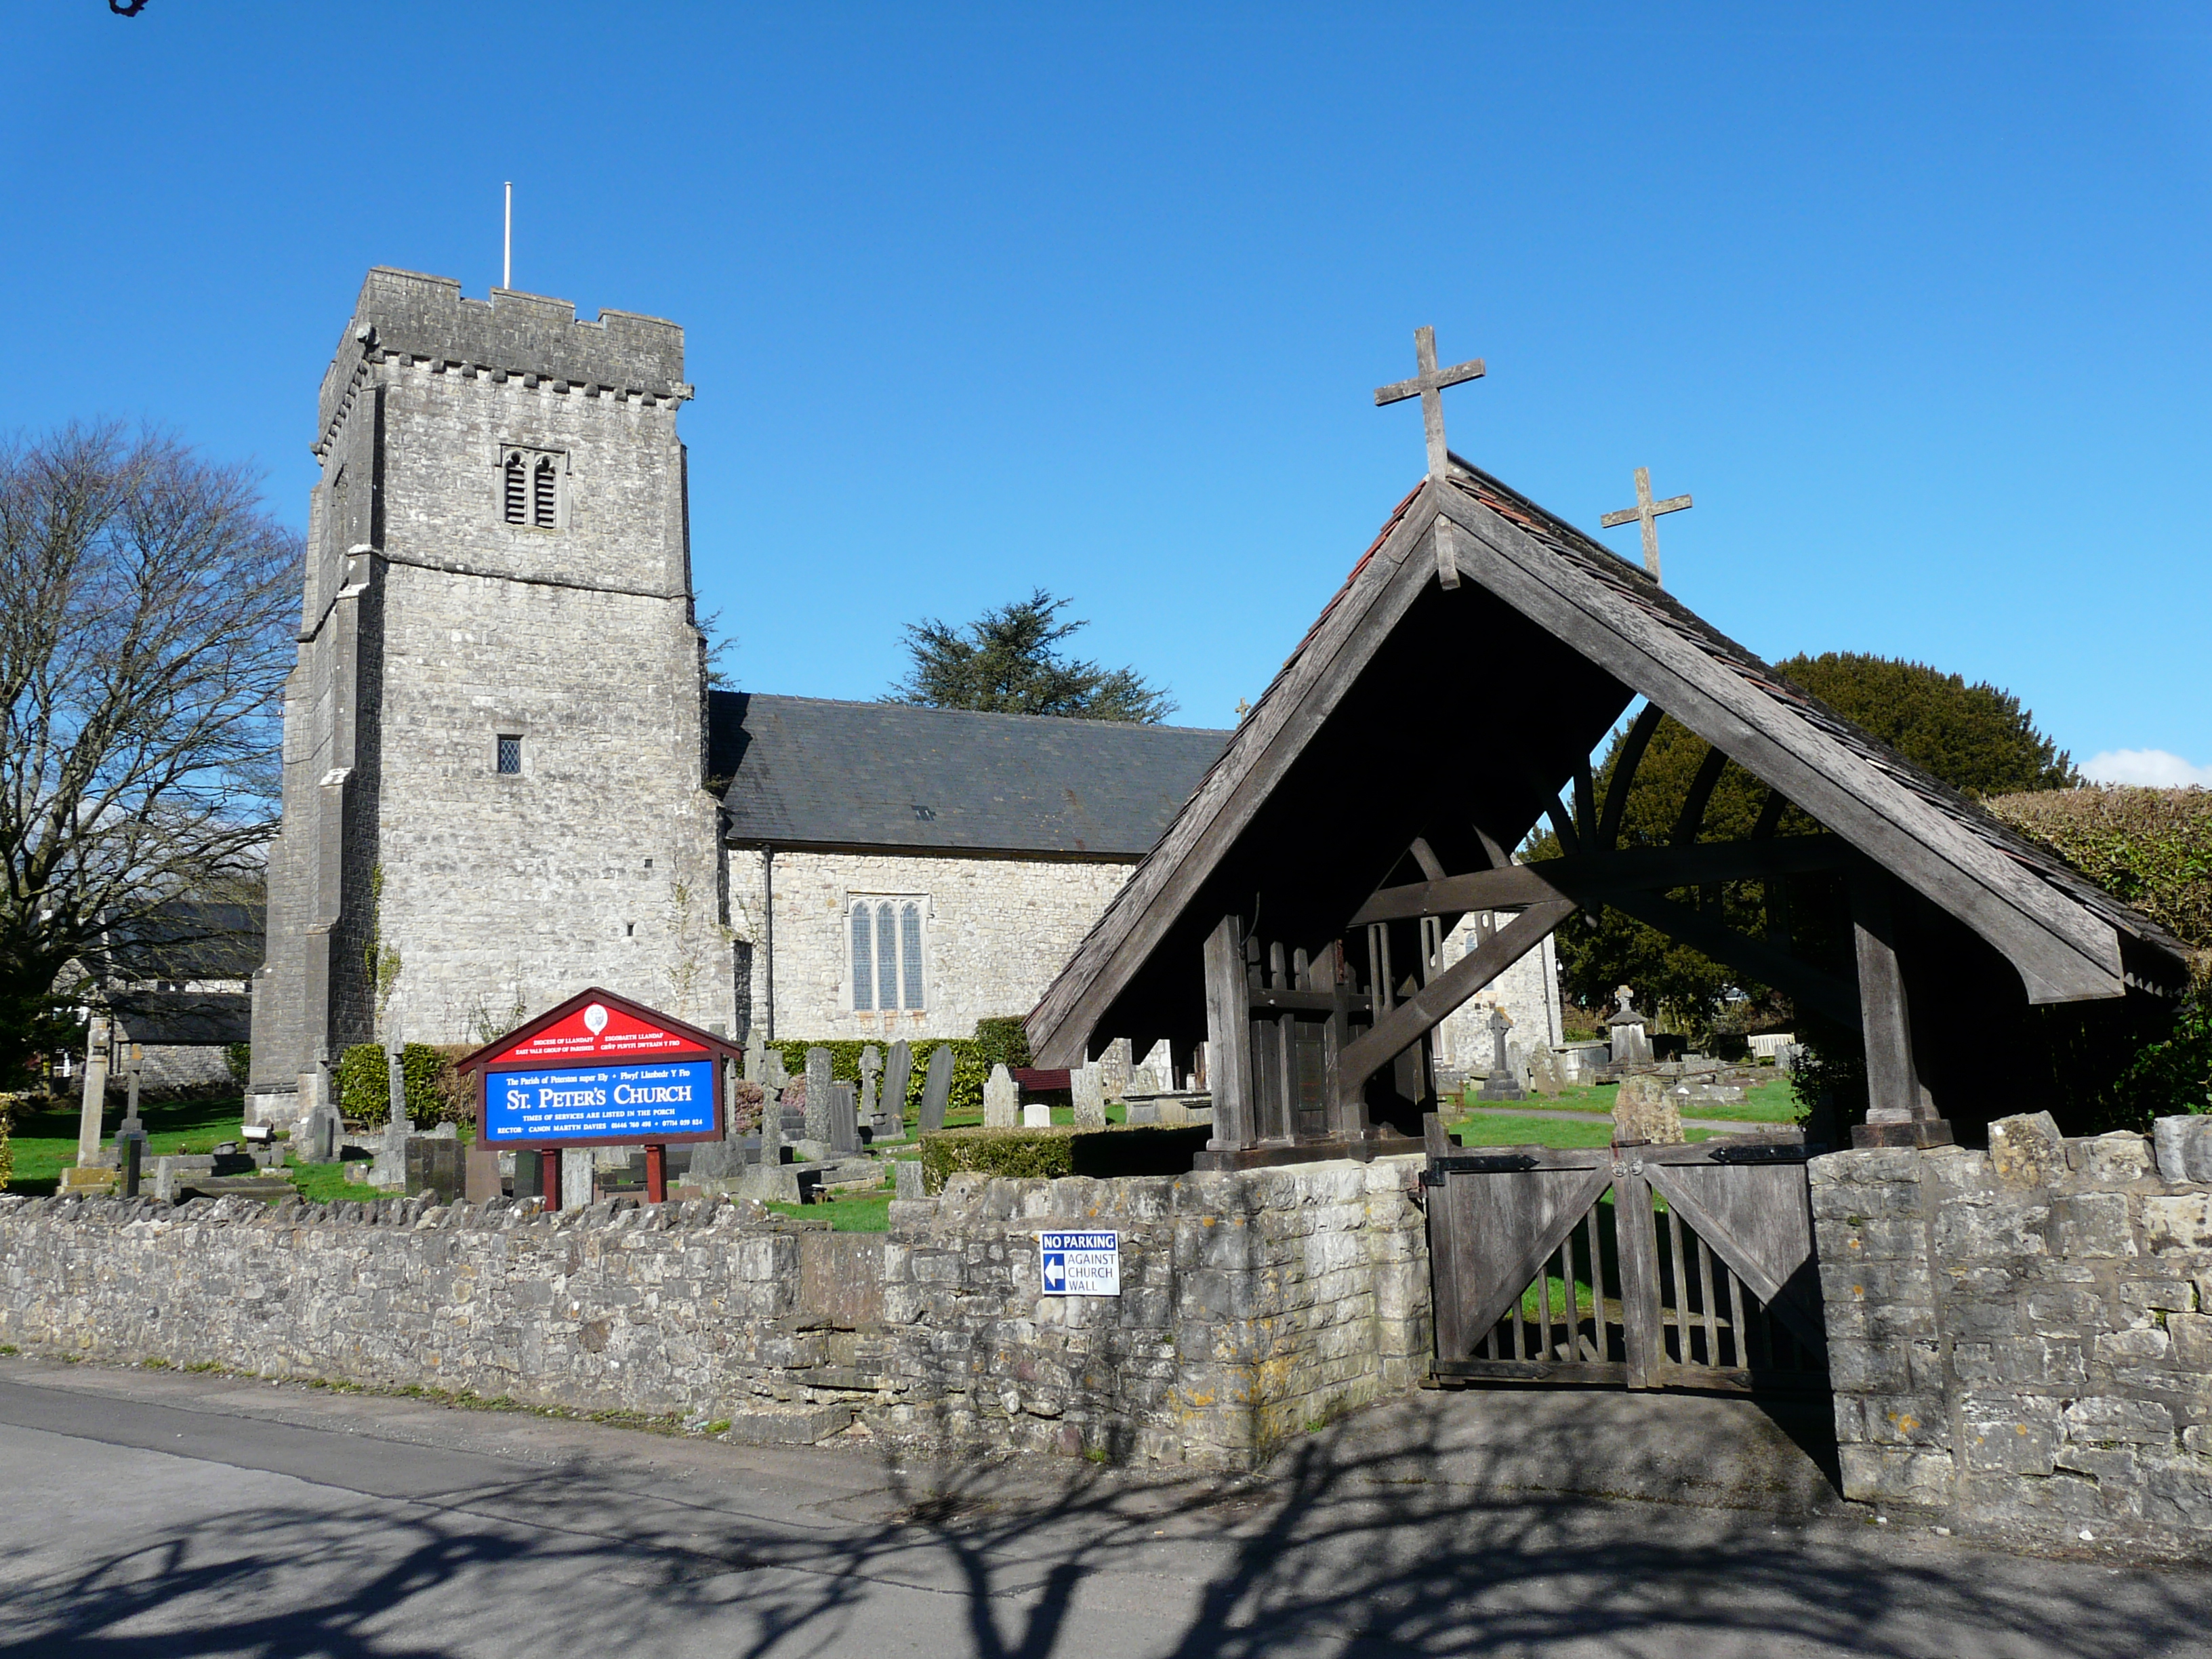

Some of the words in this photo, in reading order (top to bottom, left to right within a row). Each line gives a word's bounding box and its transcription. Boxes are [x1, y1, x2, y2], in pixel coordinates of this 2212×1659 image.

[506, 1078, 518, 1086] The
[520, 1076, 539, 1085] Parish
[541, 1076, 549, 1084] of
[550, 1076, 577, 1084] Peterston
[598, 1073, 609, 1082] Ely
[620, 1071, 638, 1081] Plwyf
[640, 1070, 668, 1079] Llanbedr
[671, 1069, 676, 1078] Y
[679, 1069, 691, 1077] Fro
[613, 1084, 692, 1105] CHURCH
[583, 1122, 607, 1130] DAVIES
[1044, 1235, 1062, 1248] NO
[1064, 1235, 1114, 1248] PARKING
[1068, 1254, 1116, 1265] AGAINST
[1068, 1267, 1113, 1278] CHURCH
[1069, 1280, 1098, 1291] WALL
